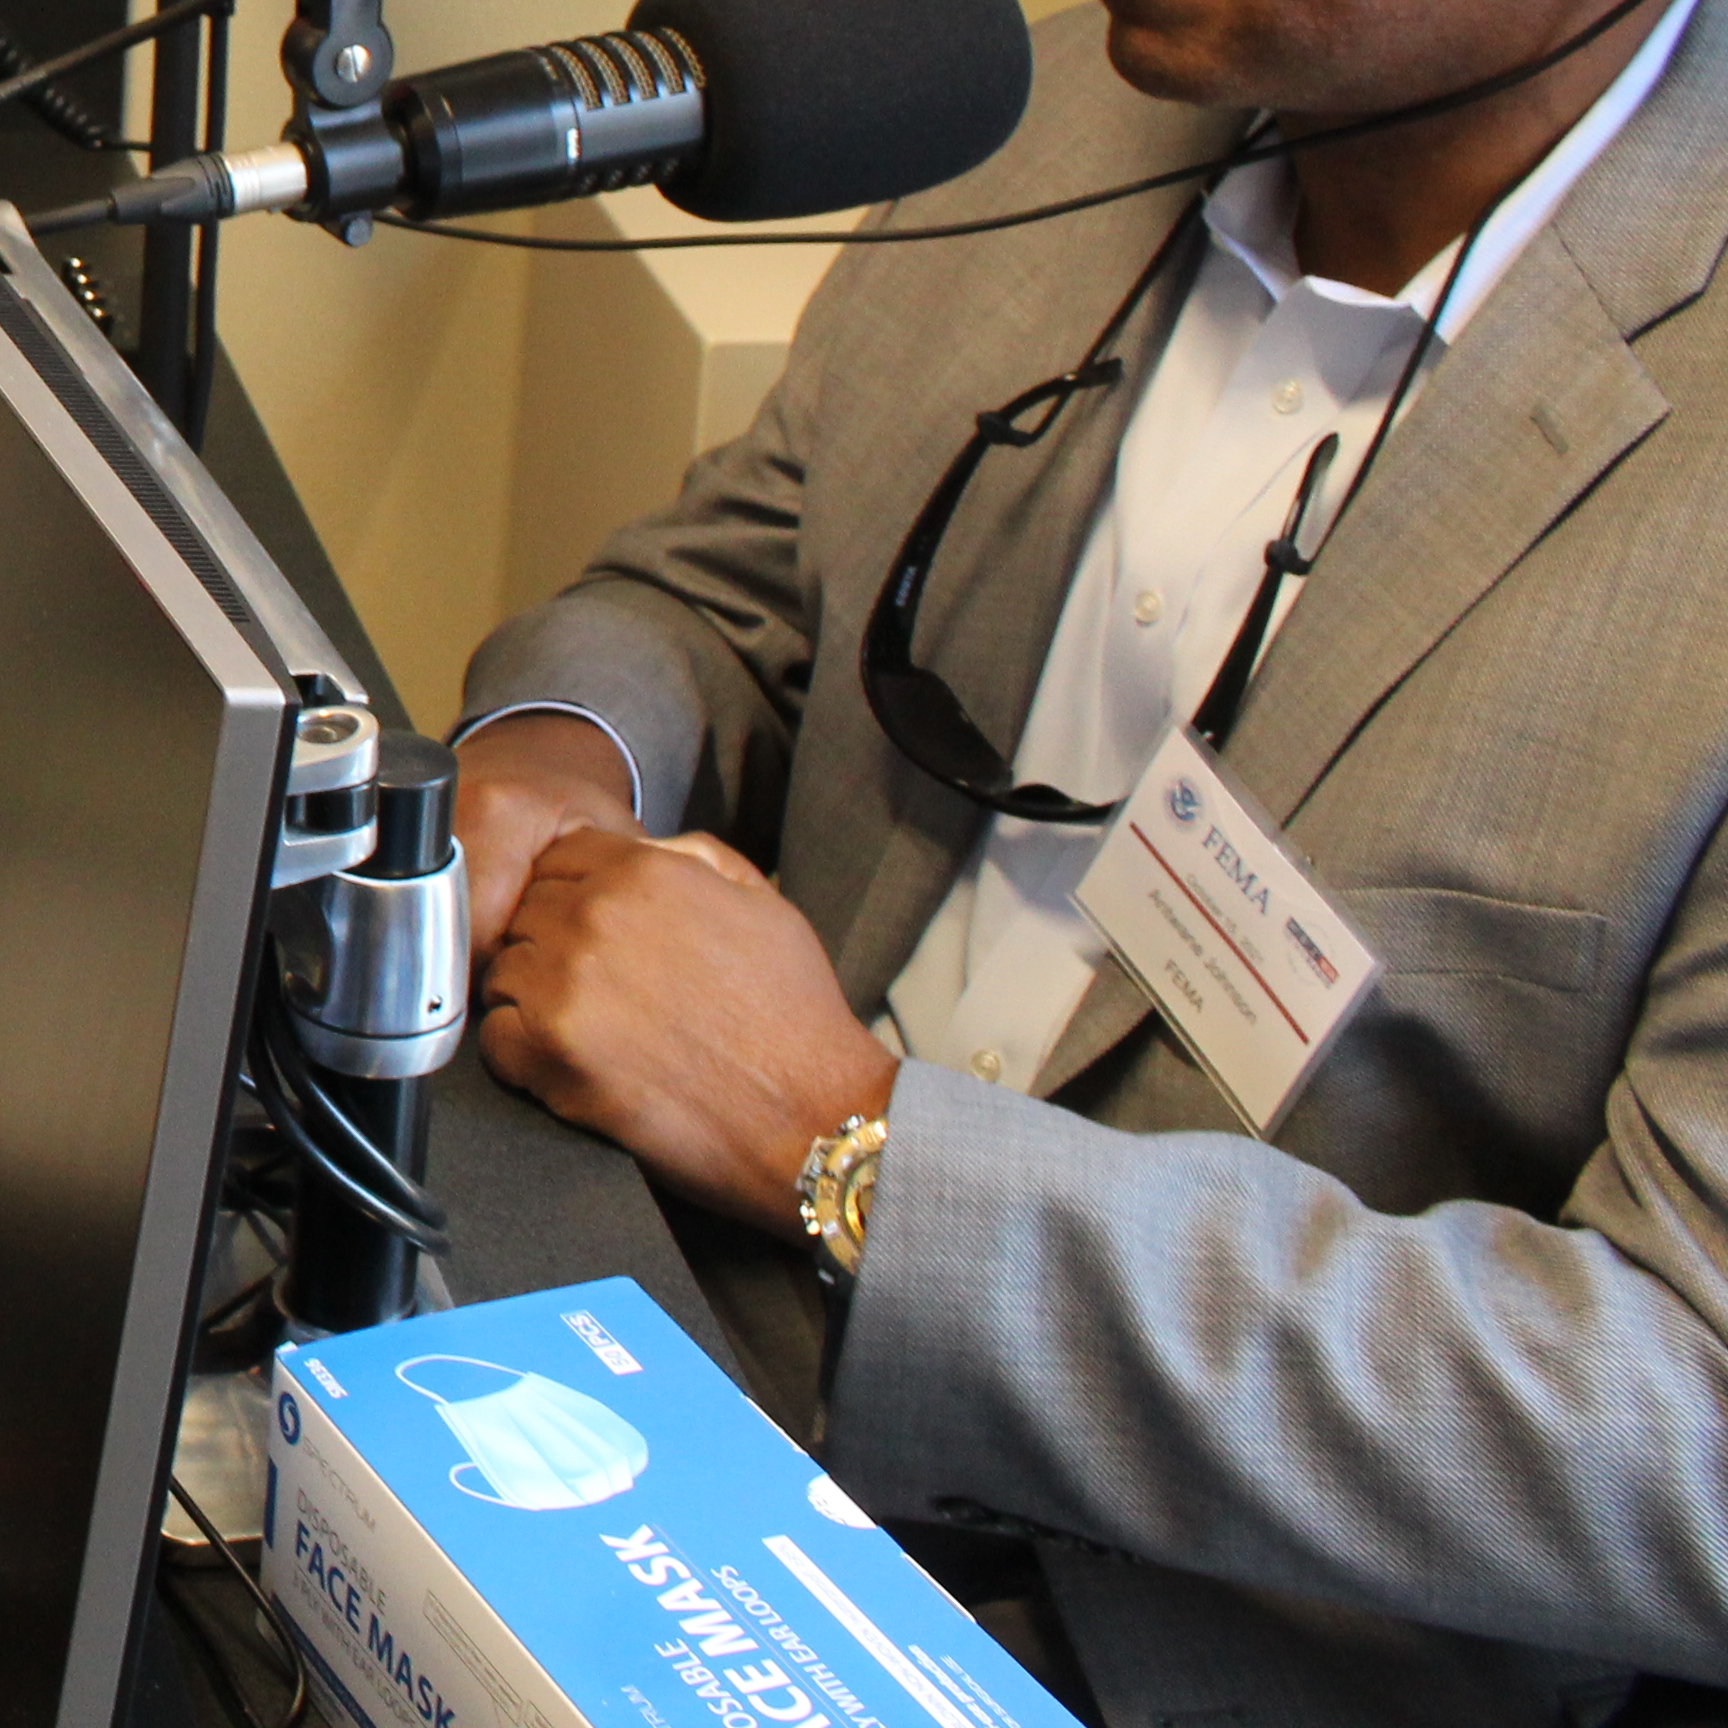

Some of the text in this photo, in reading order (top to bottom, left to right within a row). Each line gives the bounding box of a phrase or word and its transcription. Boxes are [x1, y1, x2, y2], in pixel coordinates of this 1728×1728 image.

[1202, 826, 1272, 913] FEMA
[1163, 960, 1205, 1012] FEMA
[1203, 960, 1257, 1024] Johnson
[567, 1312, 610, 1349] PCS
[300, 1435, 377, 1533] SPECTRUM
[296, 1487, 390, 1614] DISPOSABLE
[602, 1522, 759, 1661] MASK
[294, 1519, 458, 1728] FACE MASK
[711, 1561, 866, 1717] WITH EAR LOOPS
